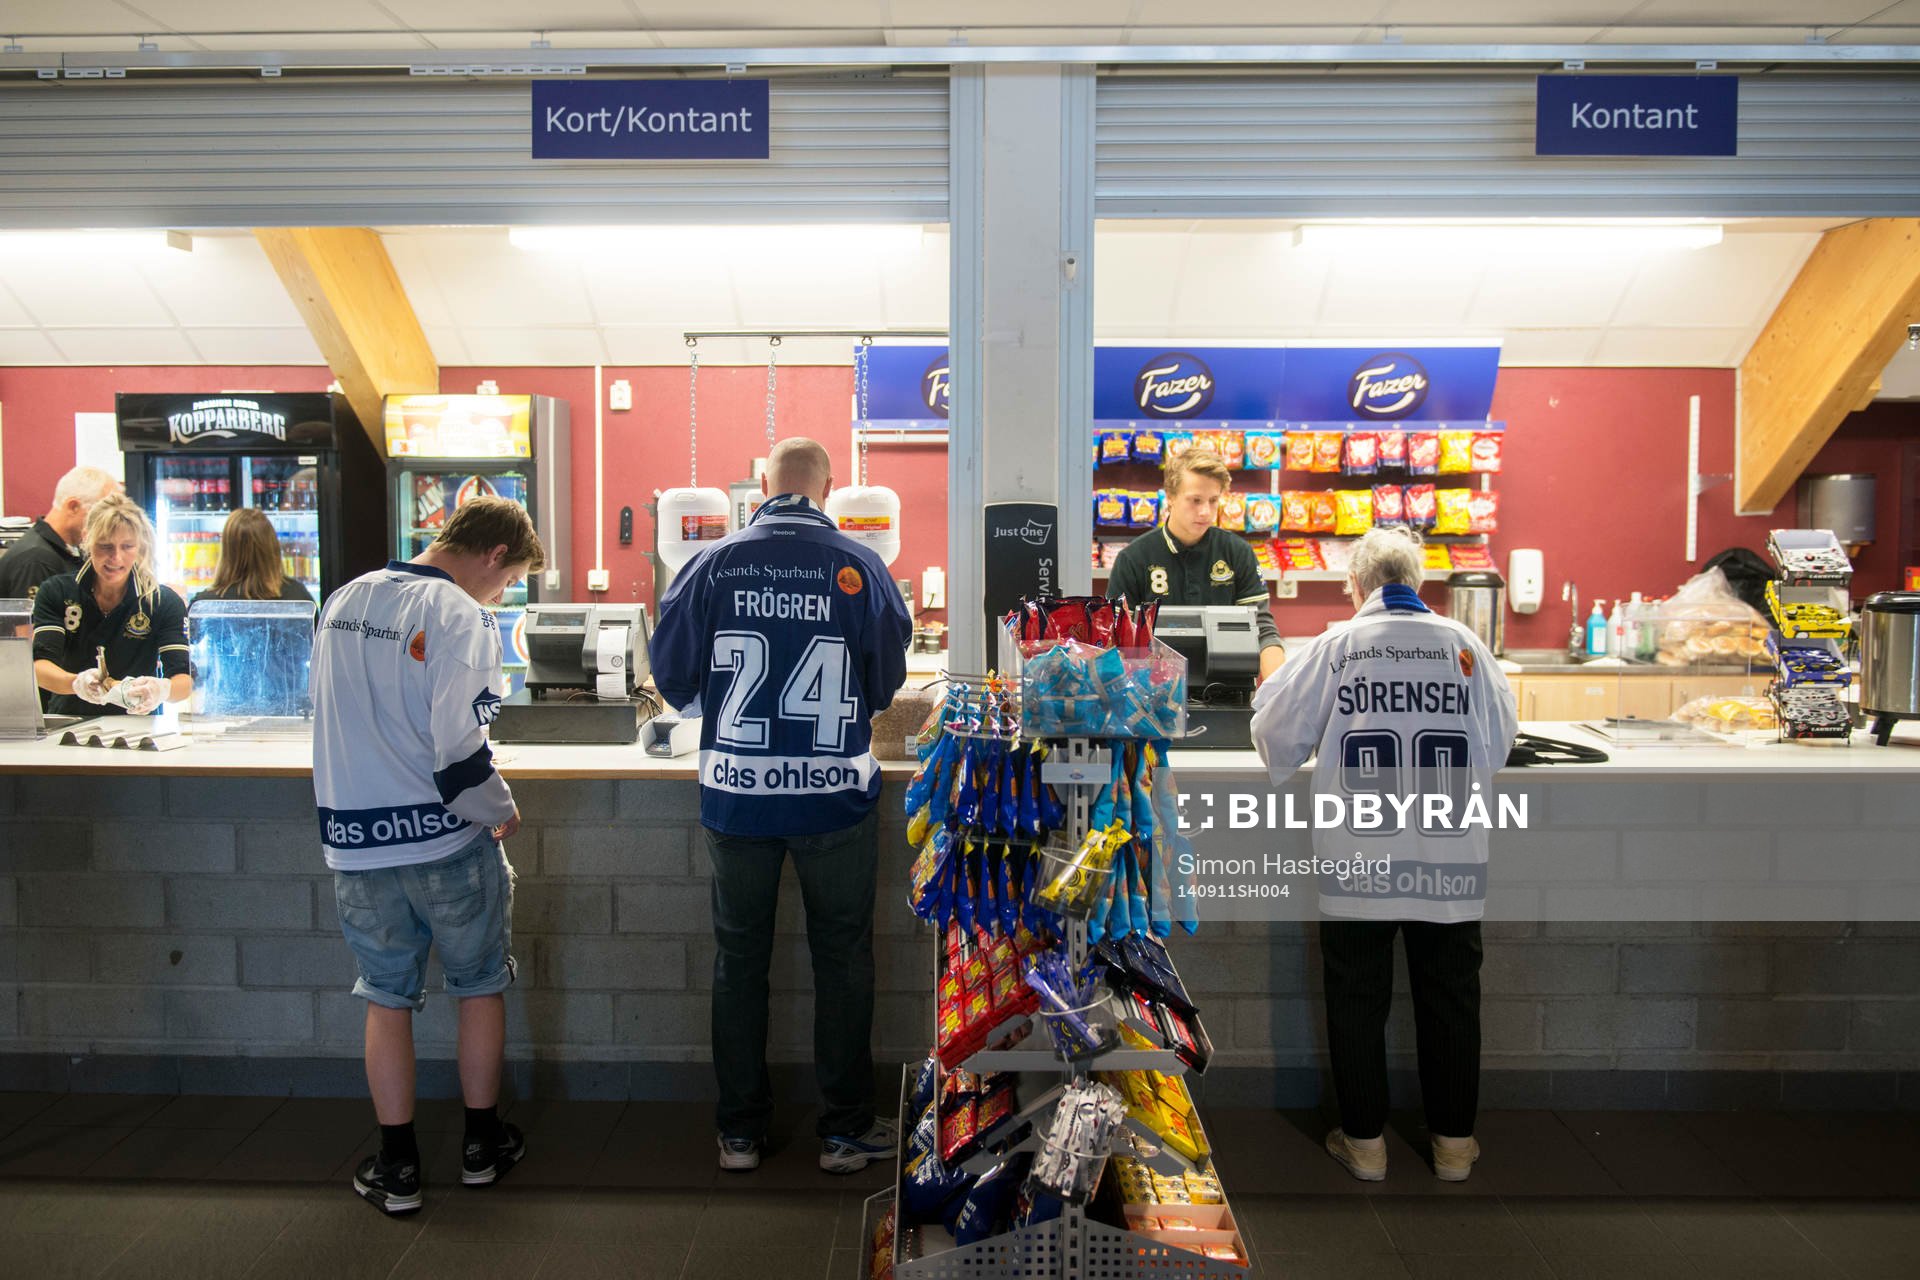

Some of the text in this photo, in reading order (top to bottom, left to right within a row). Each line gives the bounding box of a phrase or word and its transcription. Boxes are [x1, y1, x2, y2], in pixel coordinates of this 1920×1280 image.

[546, 106, 752, 137] Kort/Kontant
[1571, 102, 1698, 129] Kontant
[1141, 363, 1212, 413] Fazer
[1353, 363, 1427, 413] Fazer
[168, 407, 287, 444] KOPPARBERG
[763, 564, 826, 581] Sparbank
[1038, 558, 1053, 598] Servi
[1150, 569, 1168, 594] 8
[64, 605, 83, 632] 8
[734, 587, 831, 622] FRÖGREN
[1386, 646, 1449, 662] Sparbank
[711, 630, 858, 752] 24
[1338, 676, 1469, 716] SÖRENSEN
[714, 759, 860, 789] clas ohlson
[327, 809, 473, 845] clas ohlso
[1397, 866, 1477, 896] ohlson
